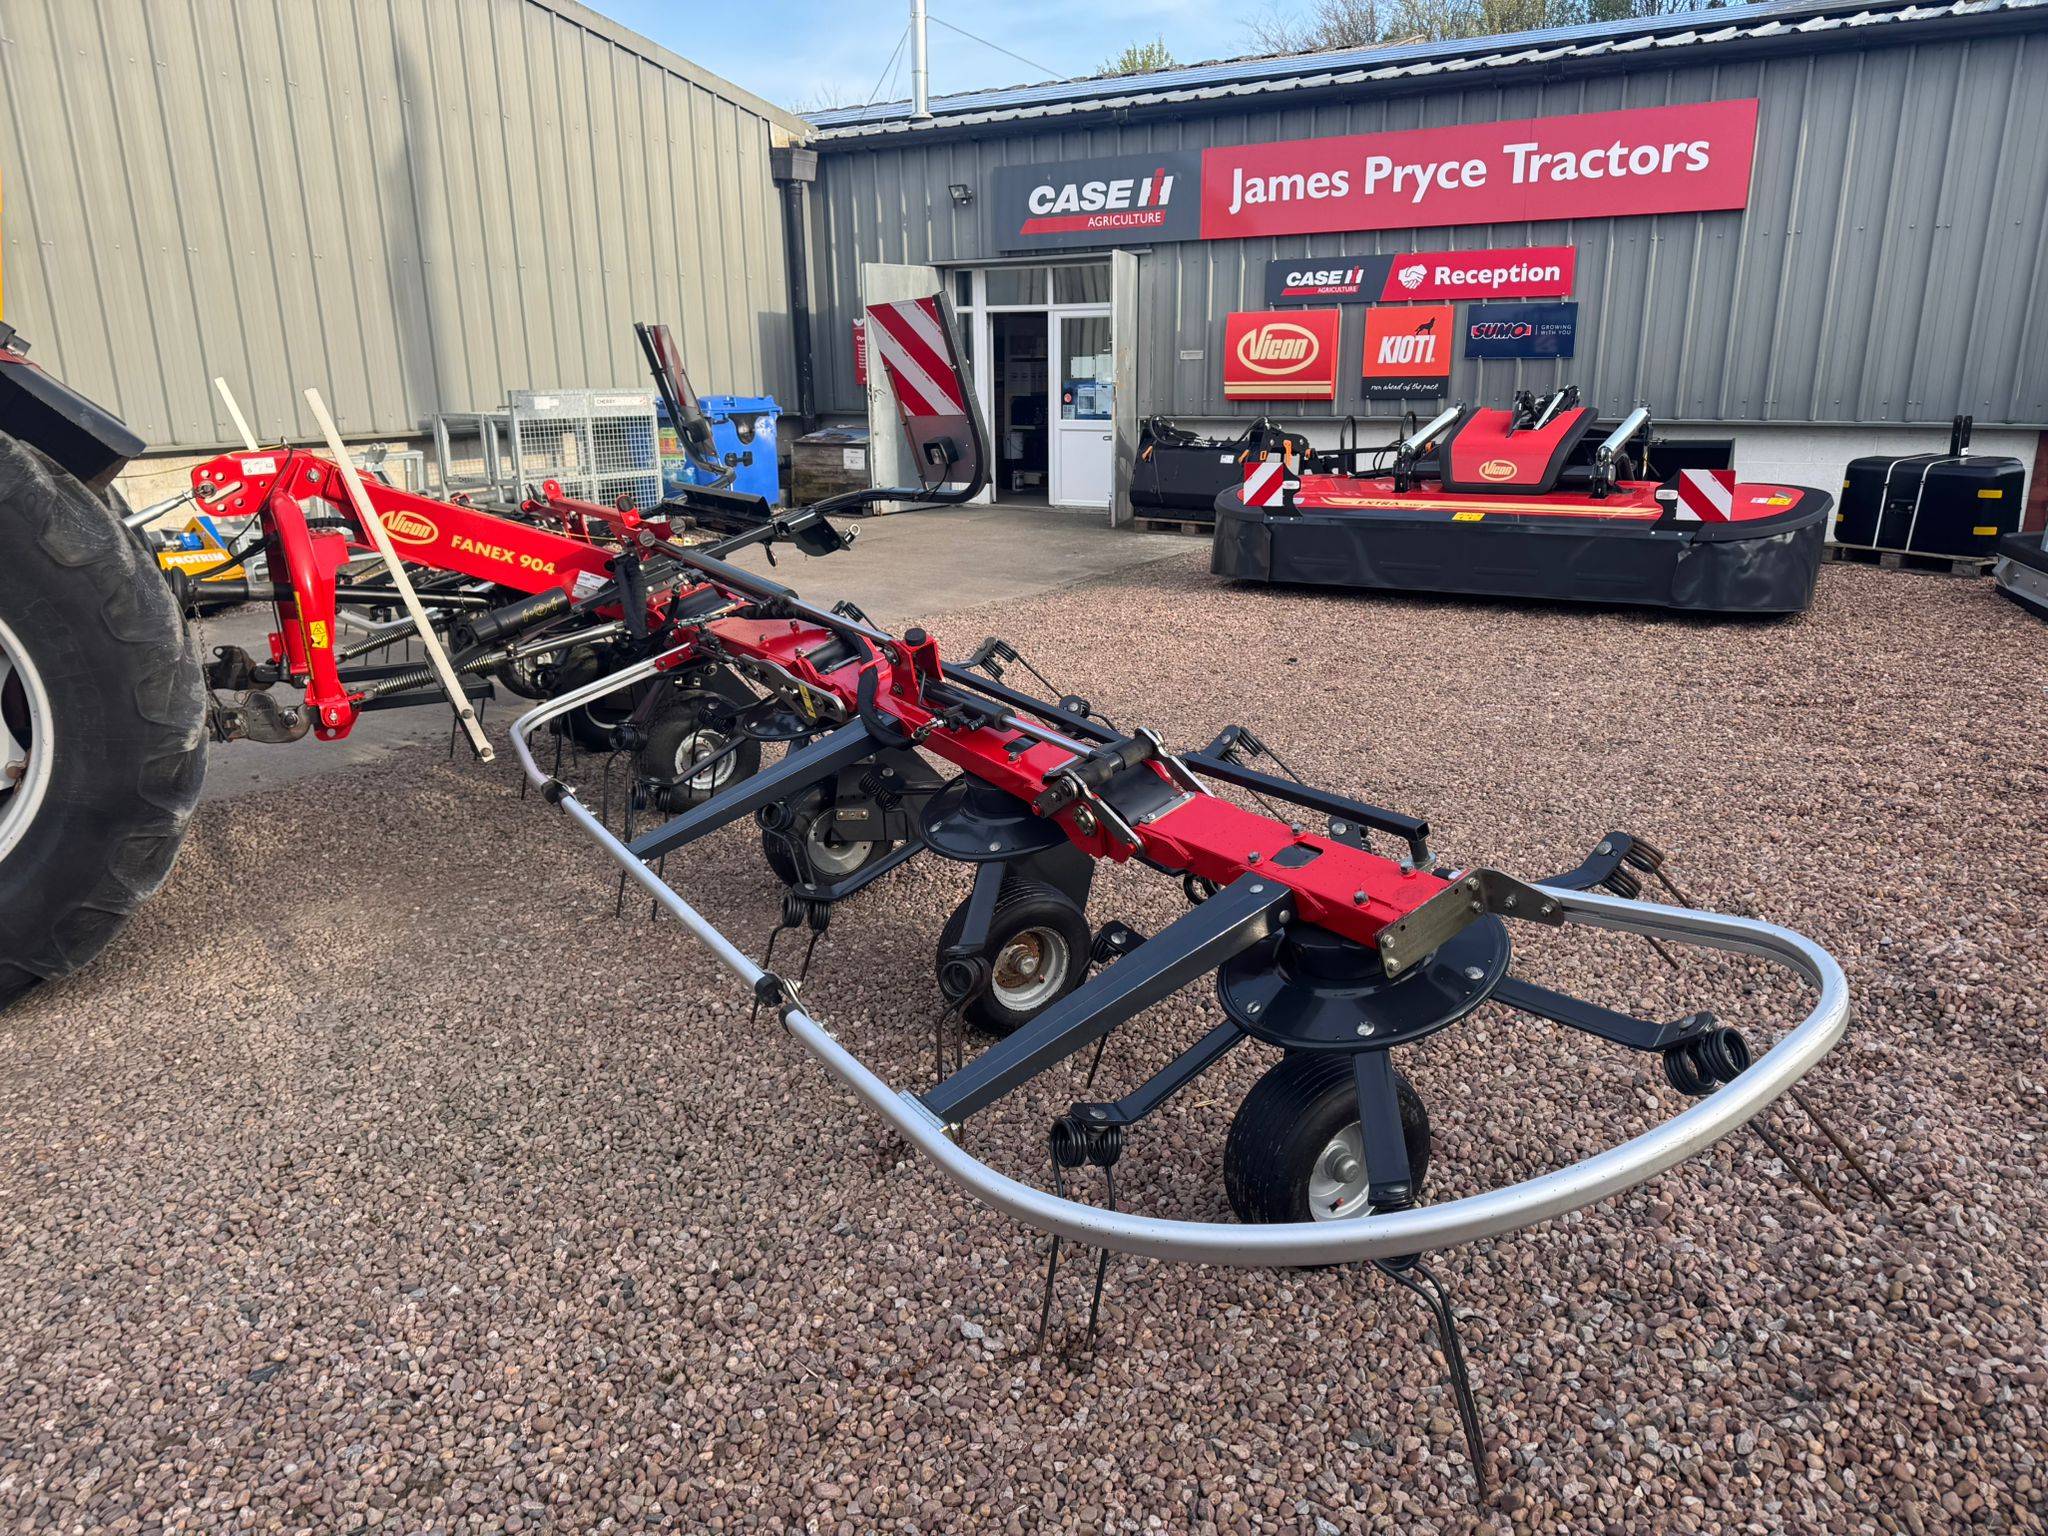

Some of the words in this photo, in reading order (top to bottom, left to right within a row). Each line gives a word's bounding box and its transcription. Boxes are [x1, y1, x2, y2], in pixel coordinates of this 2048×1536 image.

[1229, 168, 1350, 214] James
[1364, 155, 1487, 203] Pryce
[1502, 139, 1710, 184] Tractors
[1028, 179, 1135, 215] CASE
[1087, 212, 1161, 227] AGRICULTURE
[1286, 269, 1344, 286] CASE
[1434, 263, 1560, 288] Reception
[1317, 285, 1358, 294] AGRICULTURE
[1249, 325, 1309, 360] Vicon
[1472, 322, 1529, 339] SUMO
[1377, 334, 1437, 364] KIOTI
[1402, 383, 1412, 391] of
[1421, 384, 1439, 392] pack
[387, 511, 432, 538] Vicon
[165, 552, 227, 565] PROTRIM
[450, 534, 516, 564] FANEX
[519, 554, 556, 575] 904
